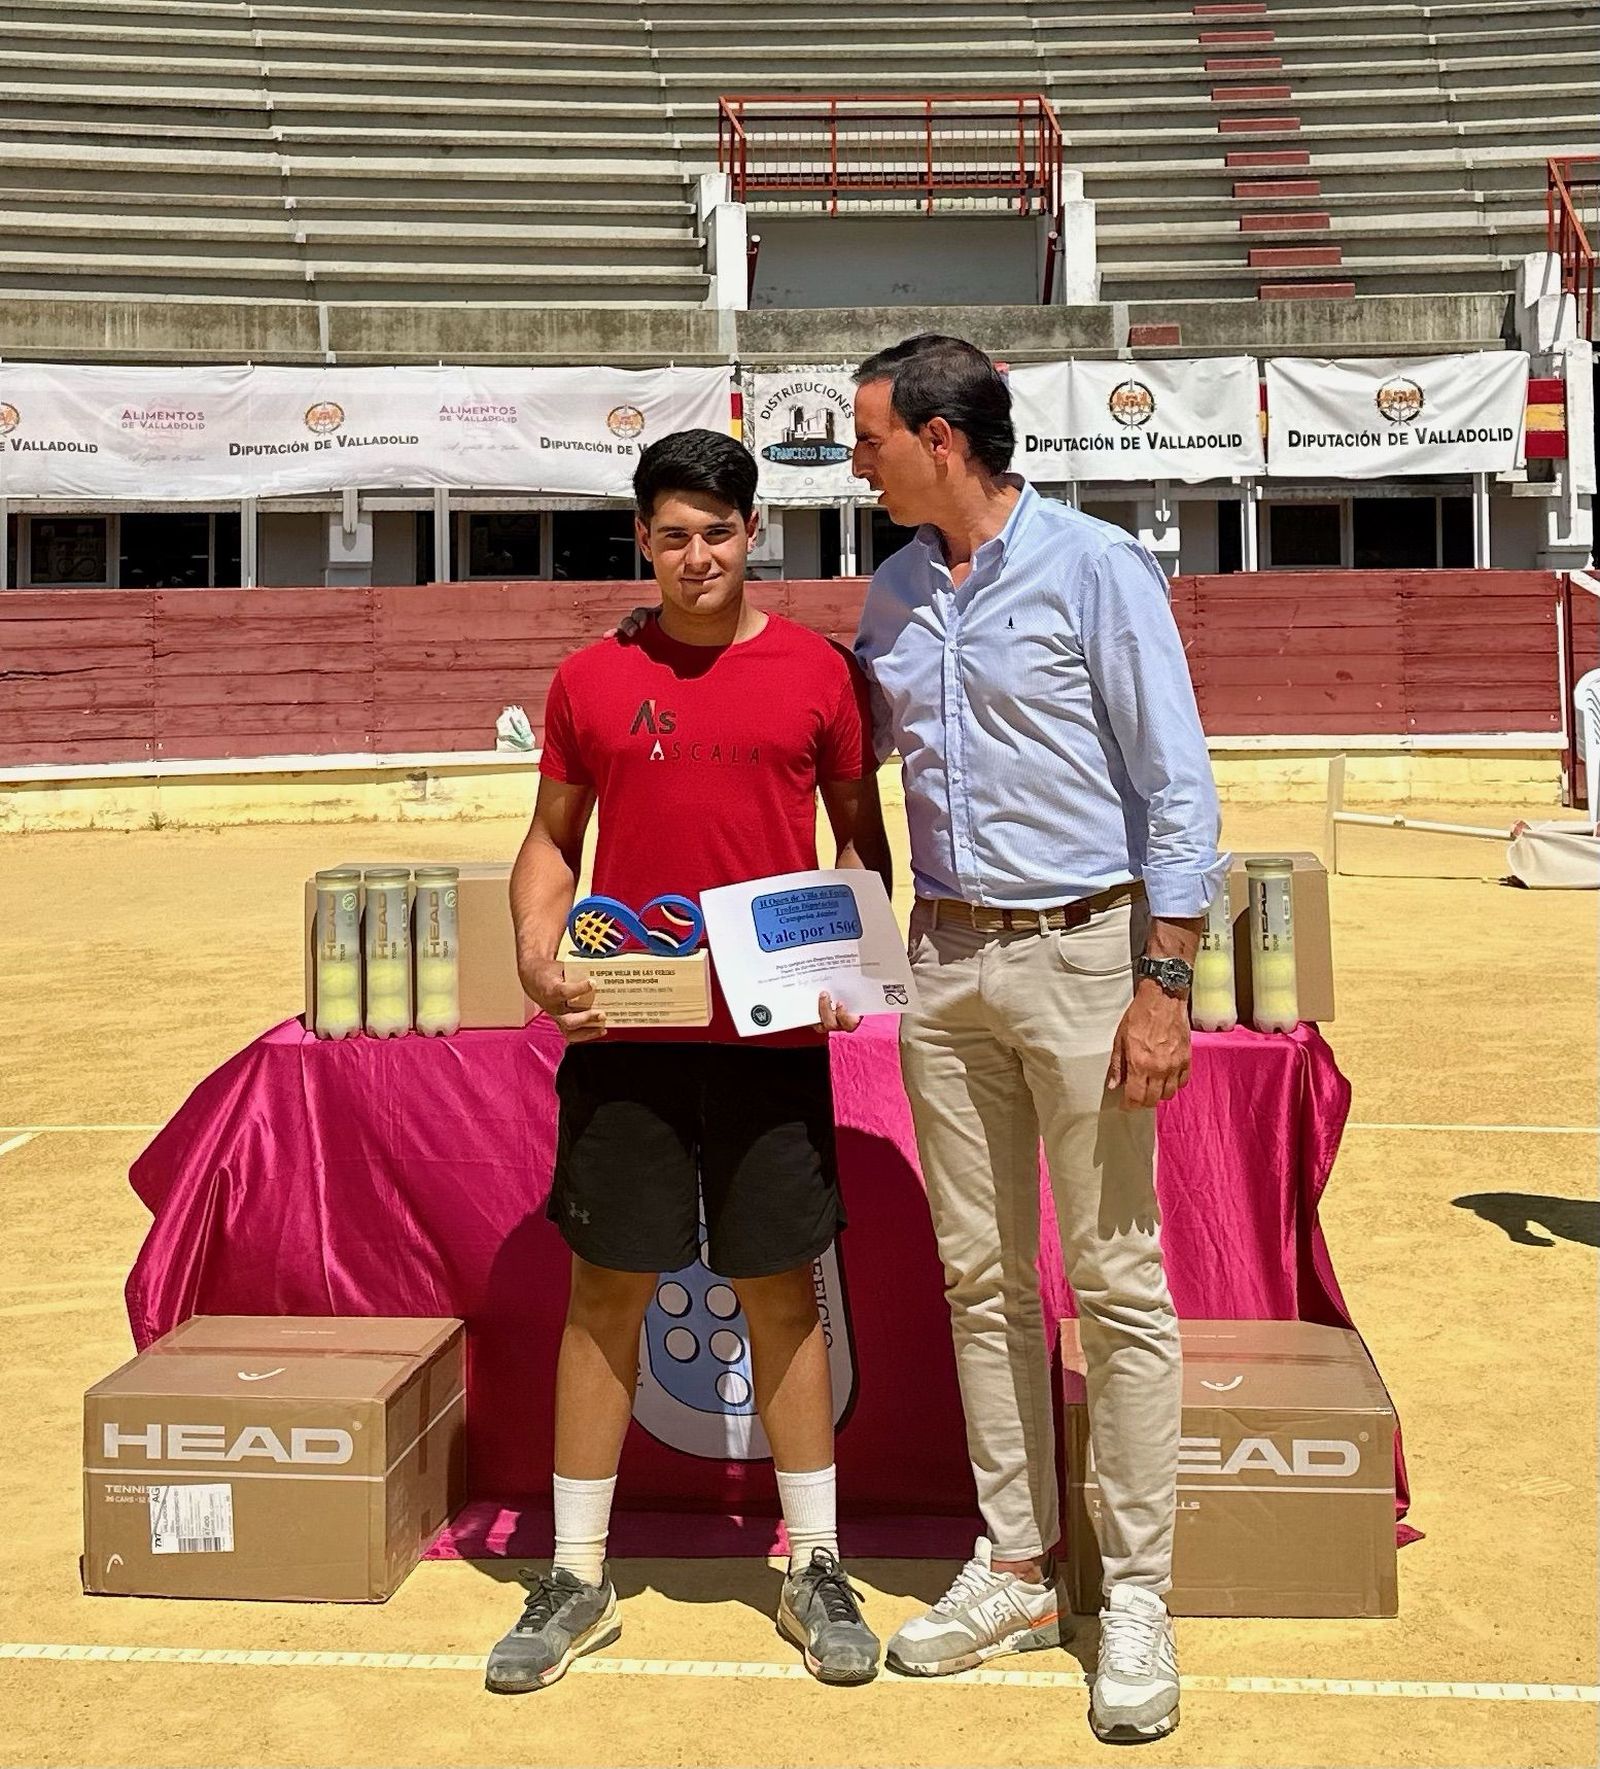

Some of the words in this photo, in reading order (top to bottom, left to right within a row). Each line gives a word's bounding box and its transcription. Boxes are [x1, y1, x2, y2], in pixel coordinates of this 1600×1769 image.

[438, 404, 517, 415] ALIMENTOS
[759, 381, 855, 420] DISTRIBUCIONES
[121, 409, 206, 421] ALIMENTOS
[121, 421, 134, 429] DE
[139, 420, 206, 431] VALLADOLID
[456, 414, 518, 424] VALLADOLID
[10, 438, 99, 454] VALLADOLID
[228, 441, 310, 457] DIPUTACIÓN
[314, 440, 332, 450] DE
[336, 434, 420, 448] VALLADOLID
[540, 436, 613, 454] DIPUTACIÓN
[617, 445, 633, 456] DE
[1025, 434, 1115, 453] DIPUTACIÓN
[1120, 436, 1141, 451] DE
[1146, 432, 1243, 450] VALLADOLID
[1288, 430, 1382, 448] DIPUTACIÓN
[1388, 433, 1409, 446] DE
[1414, 427, 1514, 445] VALLADOLID
[649, 739, 761, 765] ASCALA
[326, 893, 337, 961] HEAD
[378, 892, 389, 960] HEAD
[430, 890, 440, 958] HEAD
[761, 928, 797, 946] Vale
[800, 925, 825, 943] por
[829, 919, 860, 936] 150€
[103, 1423, 354, 1465] HEAD
[1176, 1437, 1361, 1477] EAD
